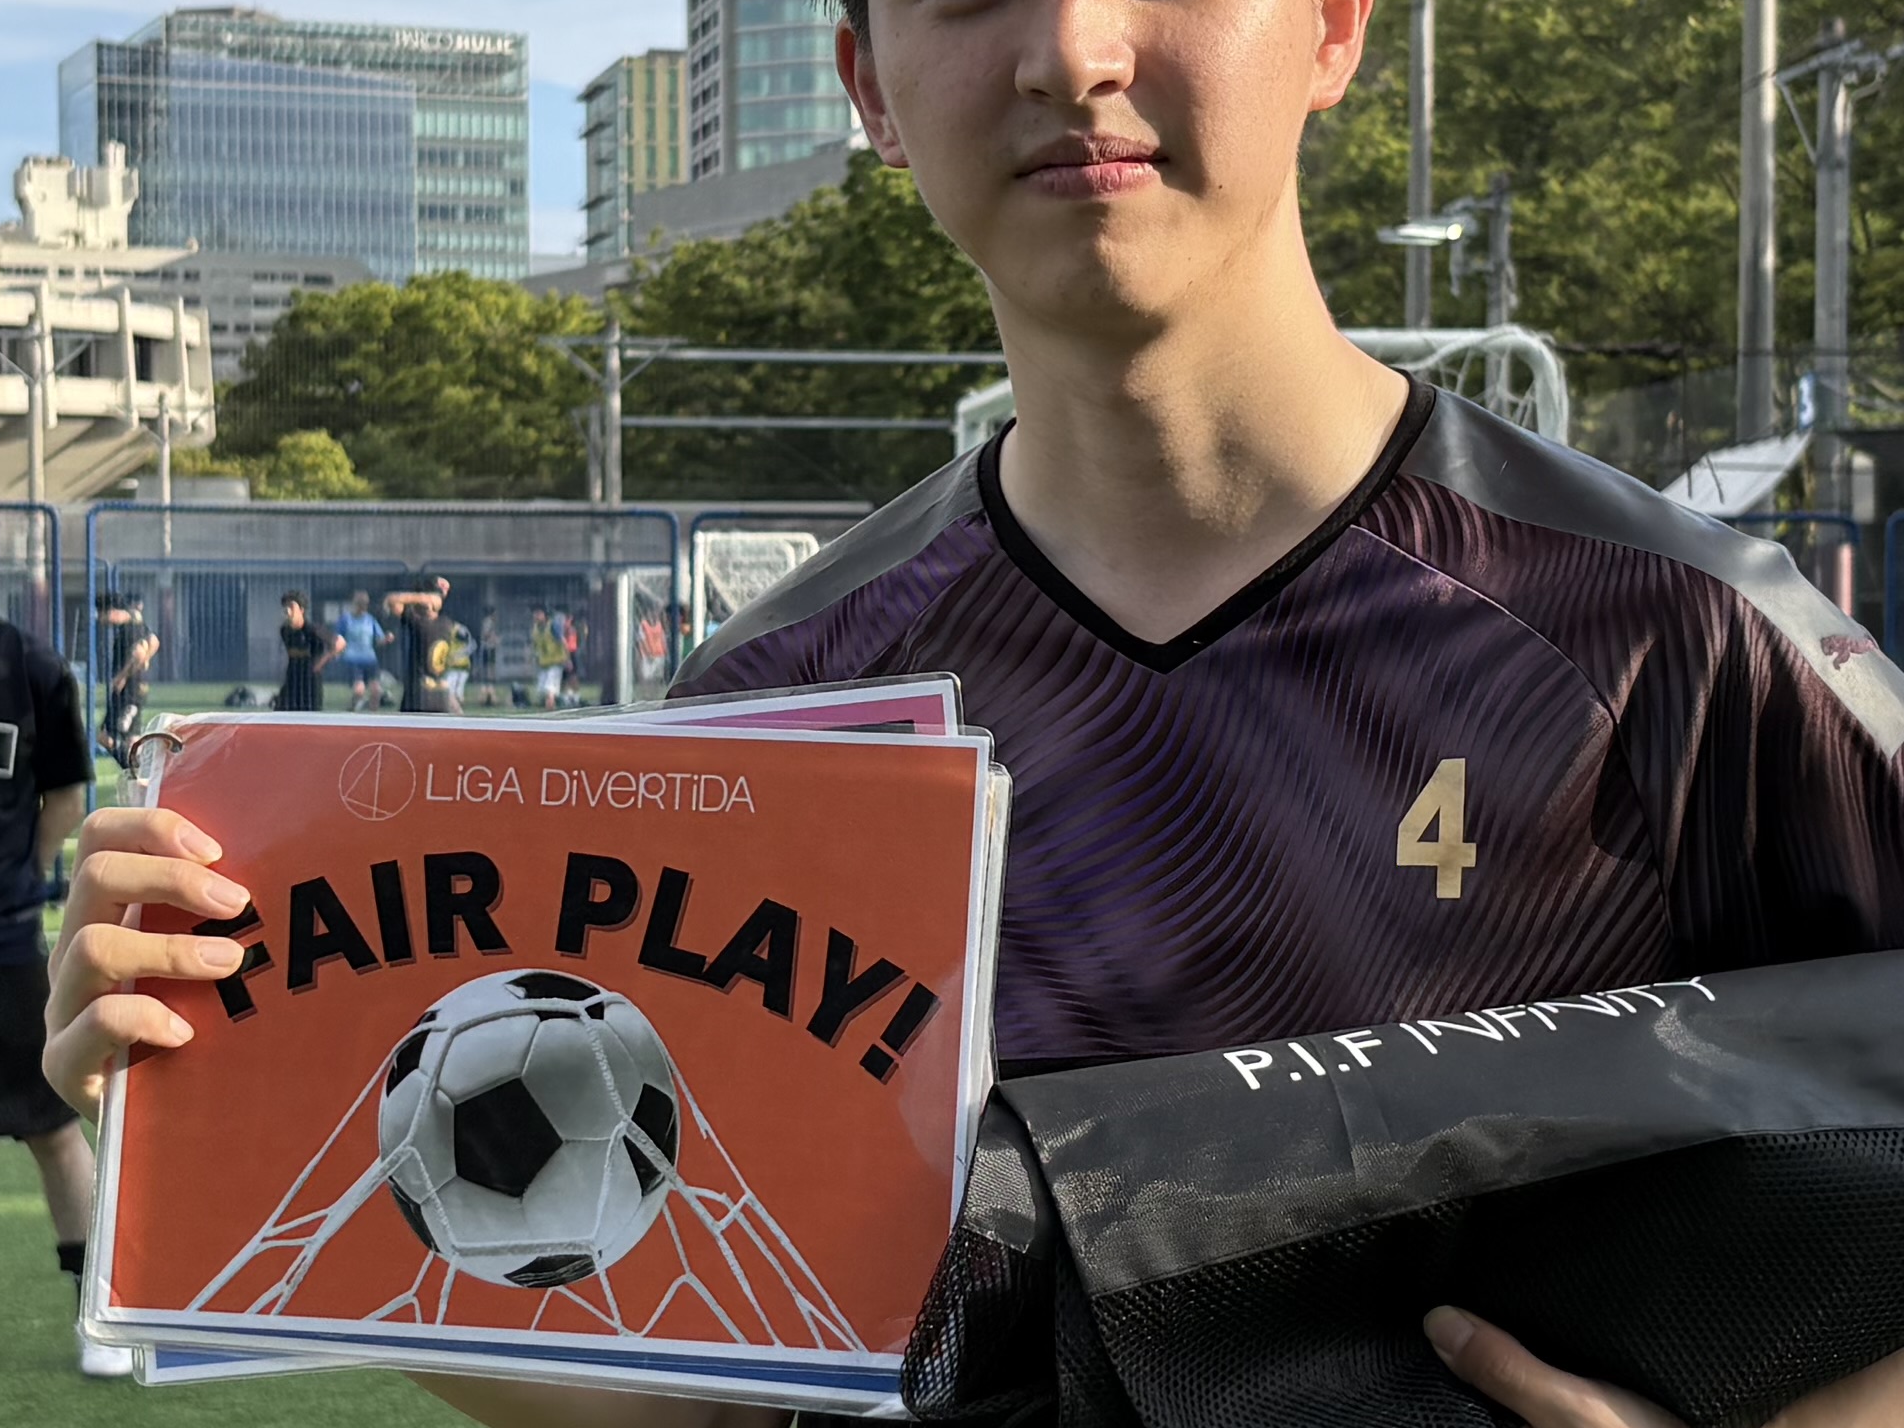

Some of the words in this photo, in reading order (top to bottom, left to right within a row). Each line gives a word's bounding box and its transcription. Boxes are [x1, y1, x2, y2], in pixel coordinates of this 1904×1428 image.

[1397, 758, 1476, 899] 4
[555, 851, 940, 1084] PLAY!
[1224, 1029, 1382, 1090] P.I.F
